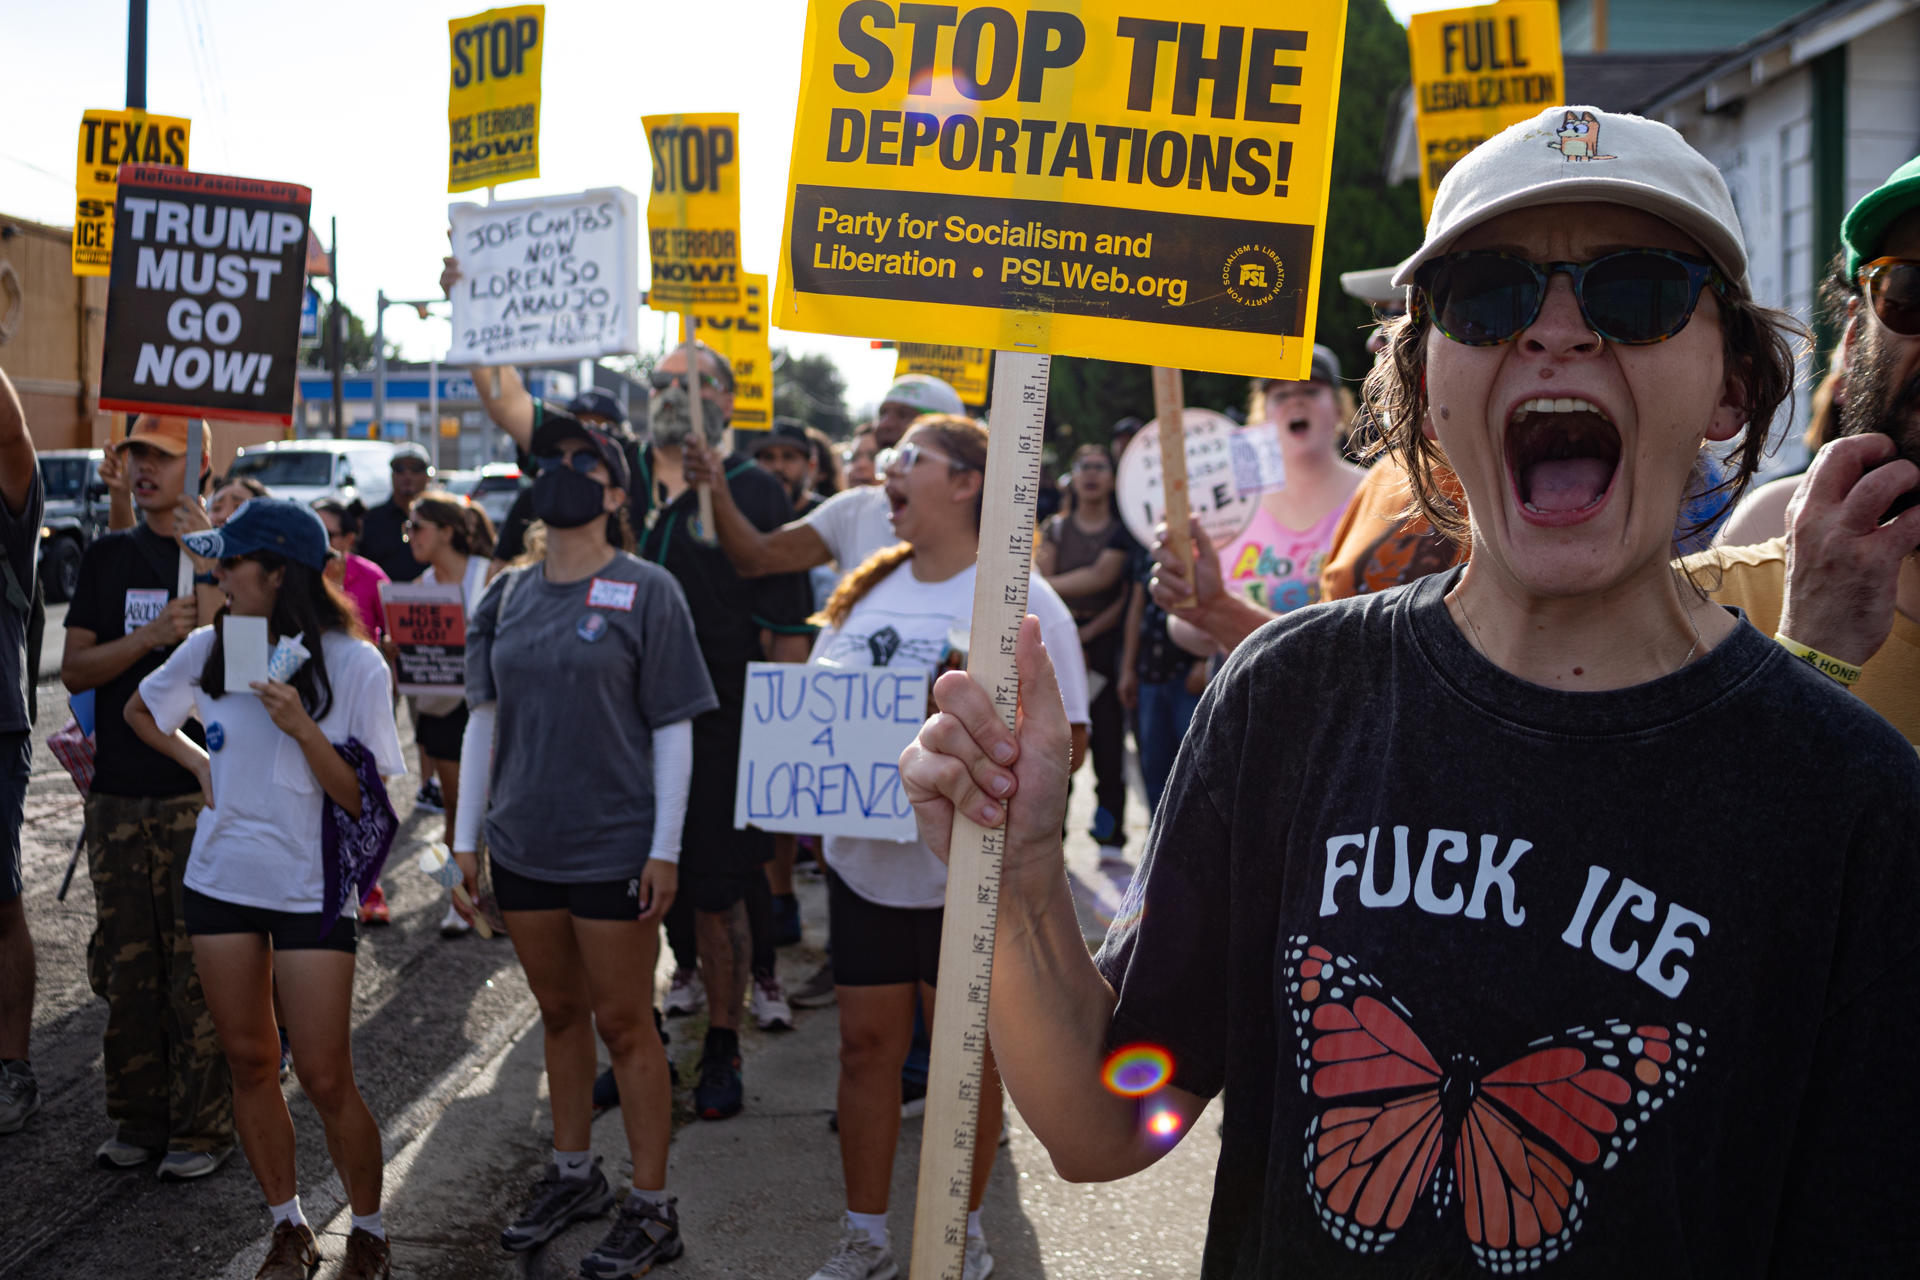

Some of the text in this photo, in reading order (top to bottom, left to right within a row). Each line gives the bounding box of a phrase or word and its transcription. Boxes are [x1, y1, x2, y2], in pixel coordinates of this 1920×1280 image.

[453, 15, 538, 90] STOP
[1443, 15, 1531, 75] FULL
[832, 0, 1309, 124] STOP THE
[1421, 73, 1557, 114] LEGALIZATION
[82, 119, 185, 167] TEXAS
[452, 134, 533, 165] NOW!
[826, 108, 1293, 198] DEPORTATIONS!
[651, 124, 735, 195] STOP
[134, 168, 298, 200] RefuseFascism.org
[77, 221, 107, 248] ICE
[123, 196, 304, 255] TRUMP
[467, 217, 523, 255] JOE
[817, 207, 1152, 259] Party for Socialism and
[136, 246, 282, 301] MUST
[653, 263, 736, 283] NOW!
[813, 242, 1188, 307] Liberation PSLWeb.org
[1222, 244, 1251, 286] SOCIALISM
[1239, 270, 1268, 288] PSL
[1262, 246, 1285, 295] LIBERATION
[1226, 286, 1243, 303] FOR
[1244, 293, 1274, 307] PARTY
[167, 297, 242, 345] GO
[133, 342, 273, 396] NOW!
[1023, 384, 1036, 400] 18
[1019, 434, 1032, 451] 19
[1014, 484, 1027, 501] 20
[1009, 535, 1022, 551] 21
[1005, 584, 1017, 601] 22
[1001, 635, 1013, 652] 23
[751, 670, 924, 724] JUSTICE
[996, 685, 1008, 702] 24
[811, 726, 835, 757] 4
[982, 835, 994, 852] 27
[978, 884, 990, 901] 28
[1319, 825, 1711, 999] FUCK ICE
[973, 934, 985, 950] 29
[968, 983, 981, 1000] 30
